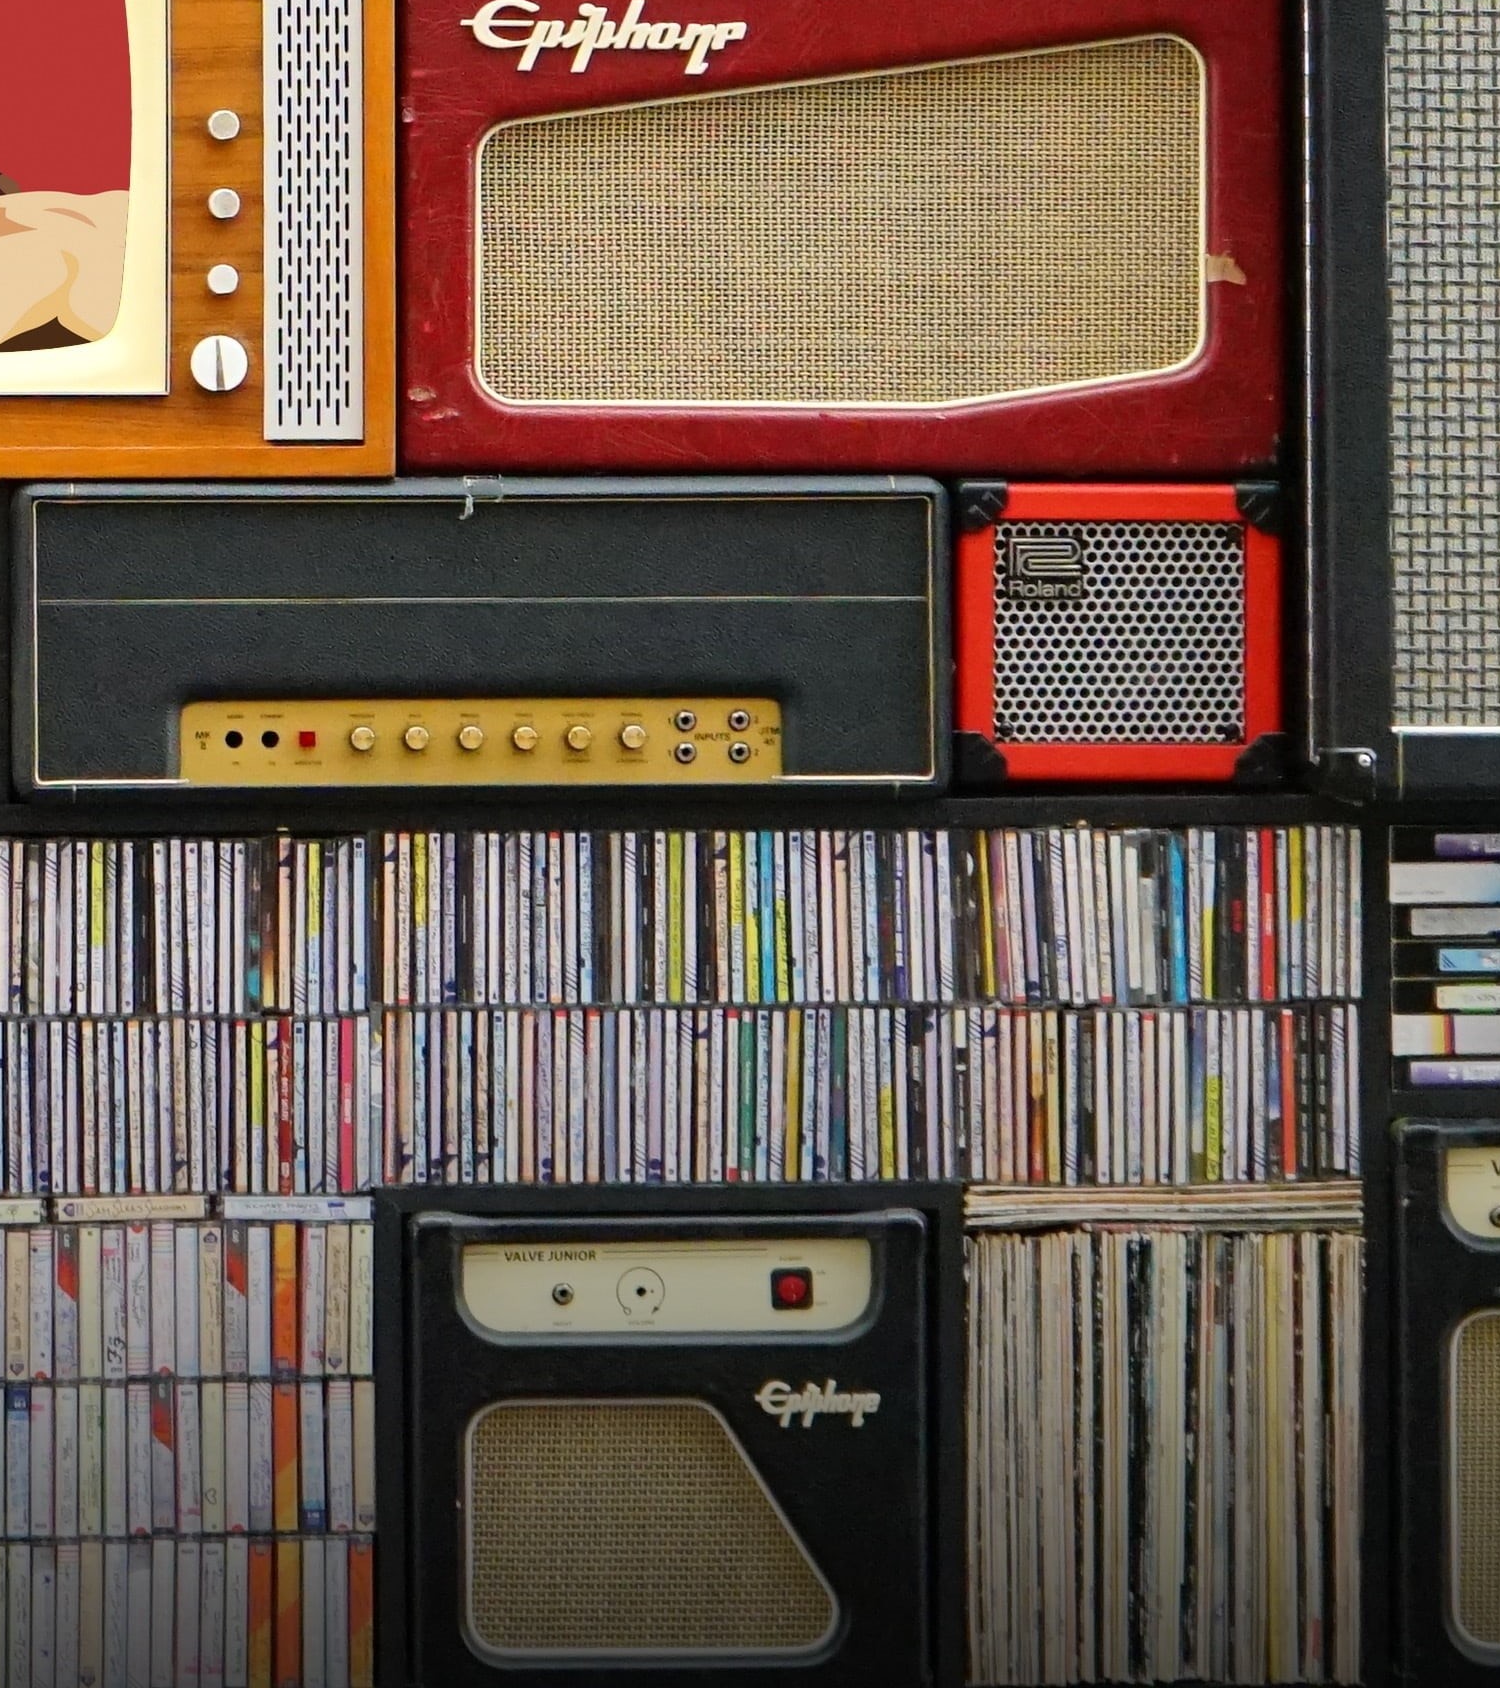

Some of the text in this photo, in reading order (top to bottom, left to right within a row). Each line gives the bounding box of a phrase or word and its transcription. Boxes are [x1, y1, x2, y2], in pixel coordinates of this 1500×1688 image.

[1009, 579, 1083, 598] Roland
[504, 1250, 597, 1262] VALVE JUNIOR
[754, 1378, 882, 1428] Epiphone
